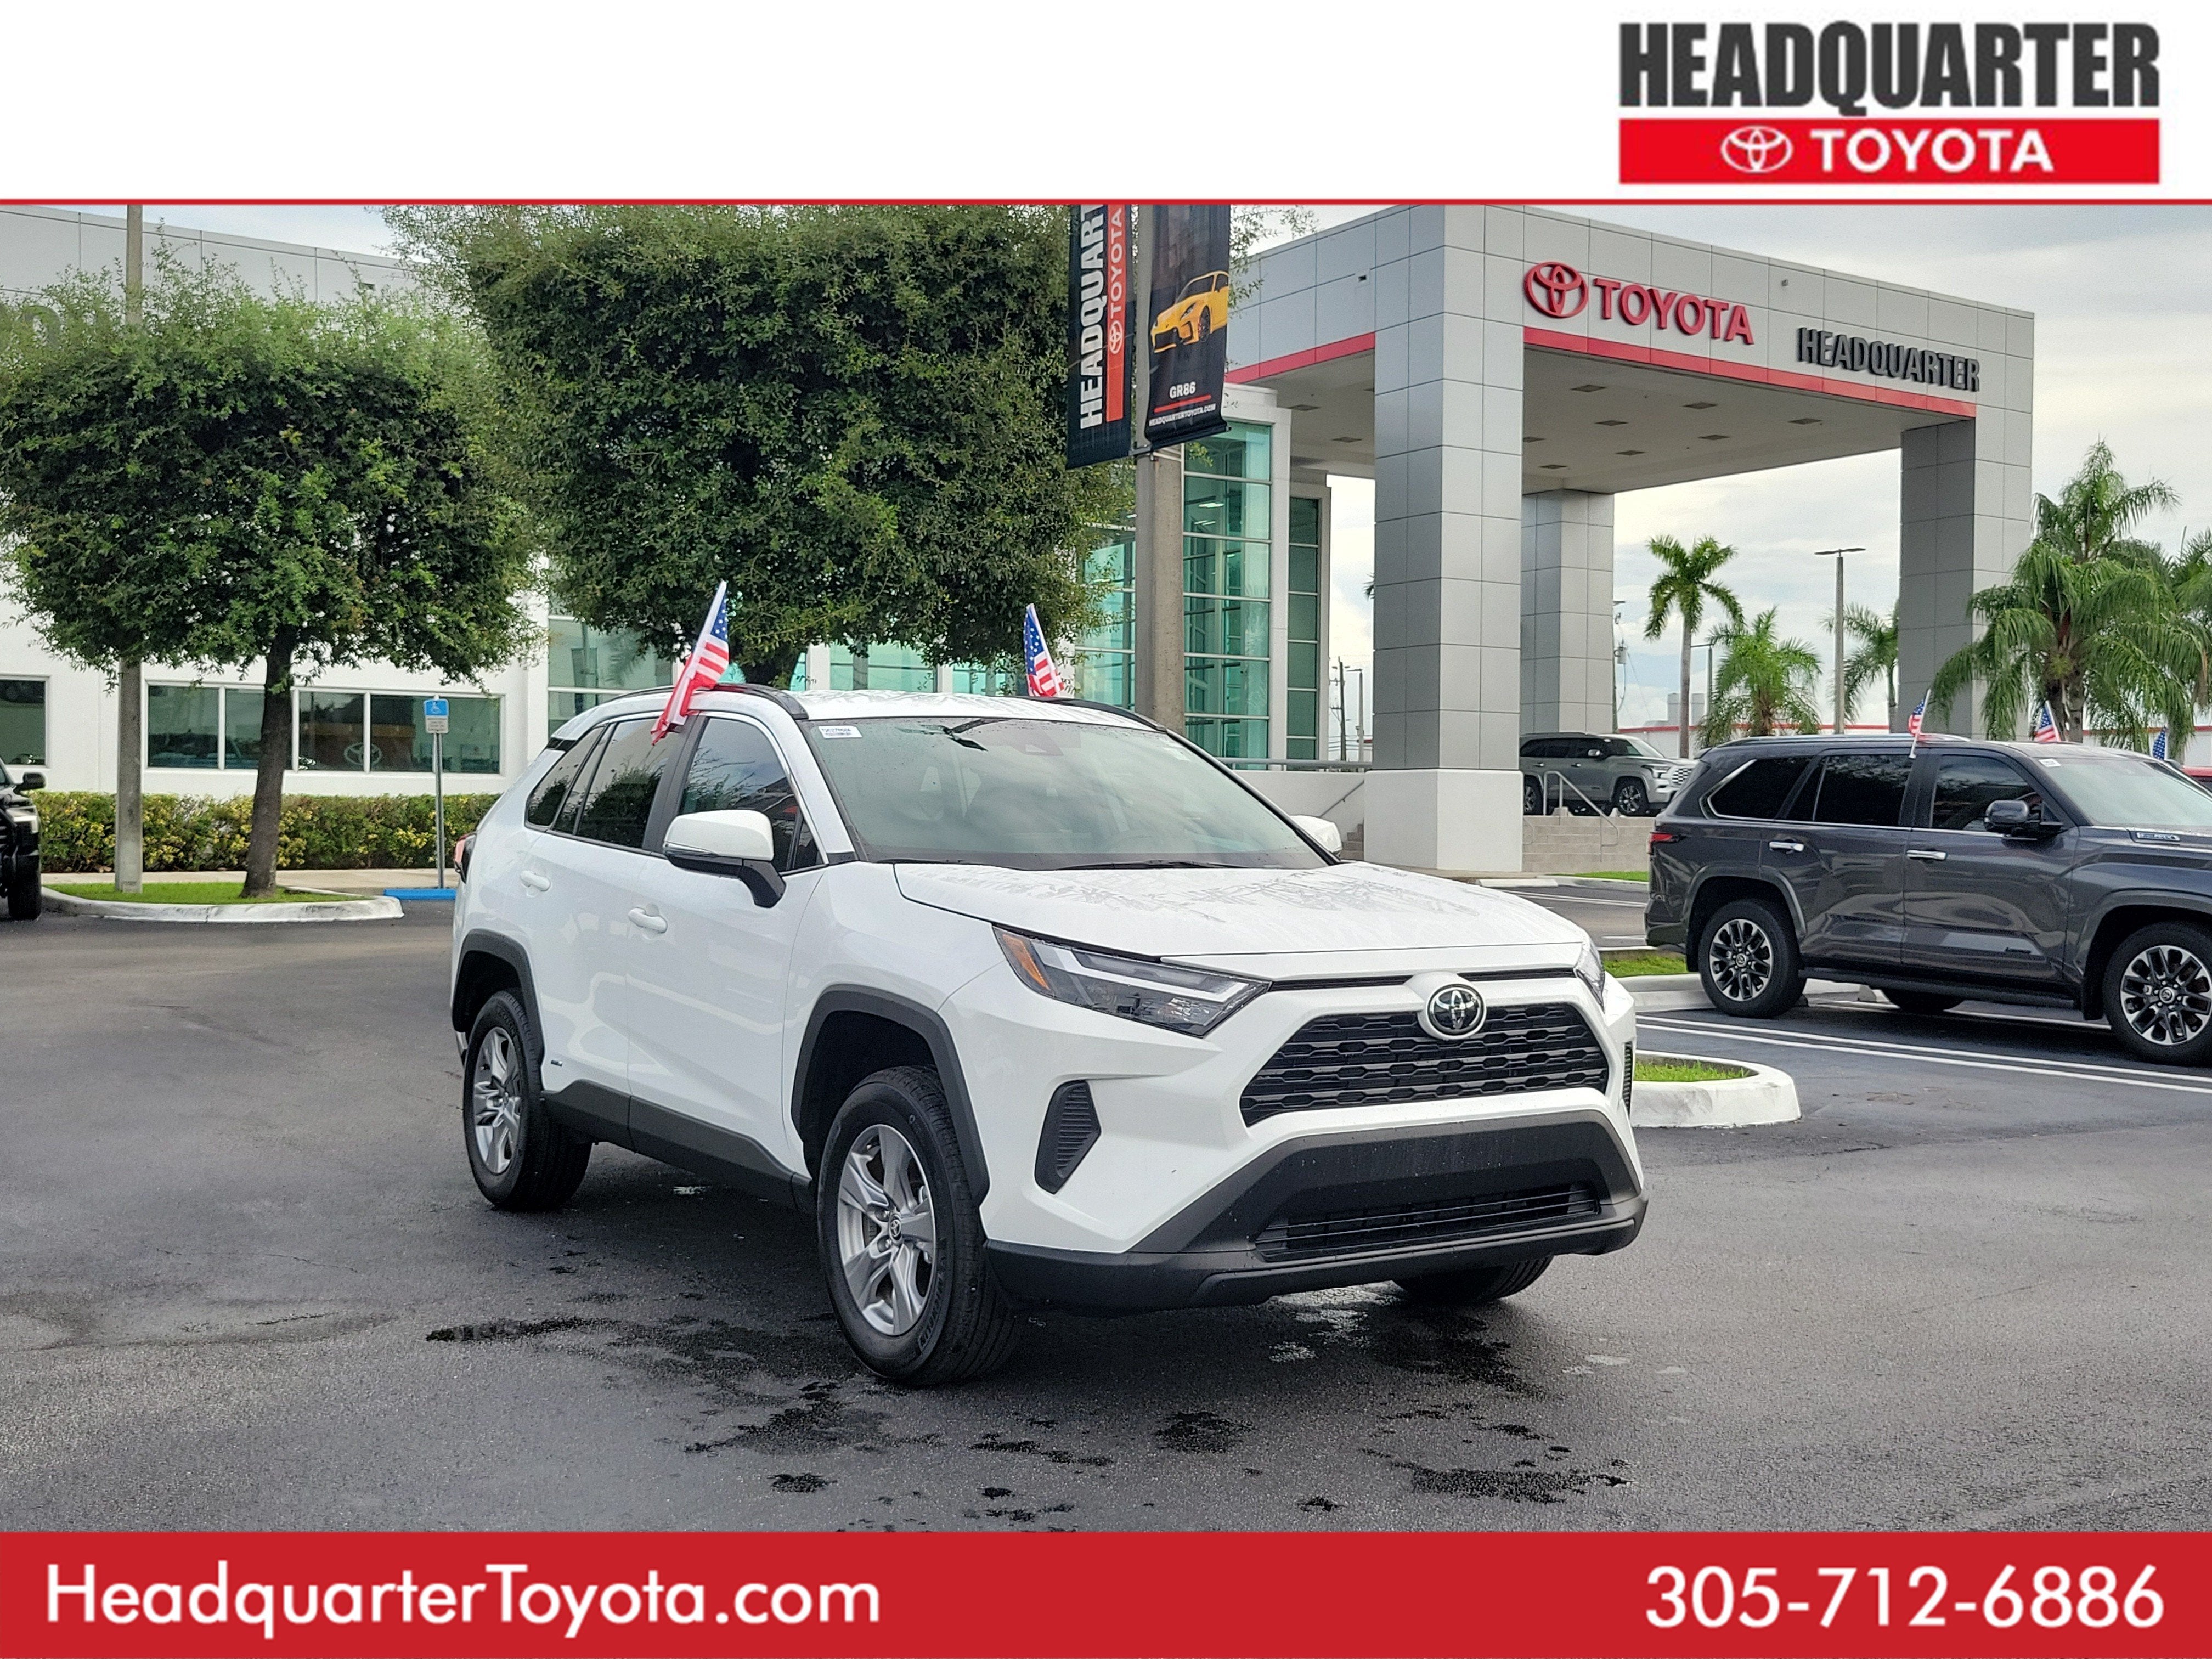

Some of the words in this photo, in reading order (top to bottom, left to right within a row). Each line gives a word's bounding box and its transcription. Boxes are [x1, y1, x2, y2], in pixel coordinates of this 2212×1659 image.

[1111, 207, 1122, 319] TOYOTA
[1593, 278, 1754, 346] TOYOTA
[1169, 381, 1196, 399] GR86
[1797, 328, 1979, 393] HEADQUARTER
